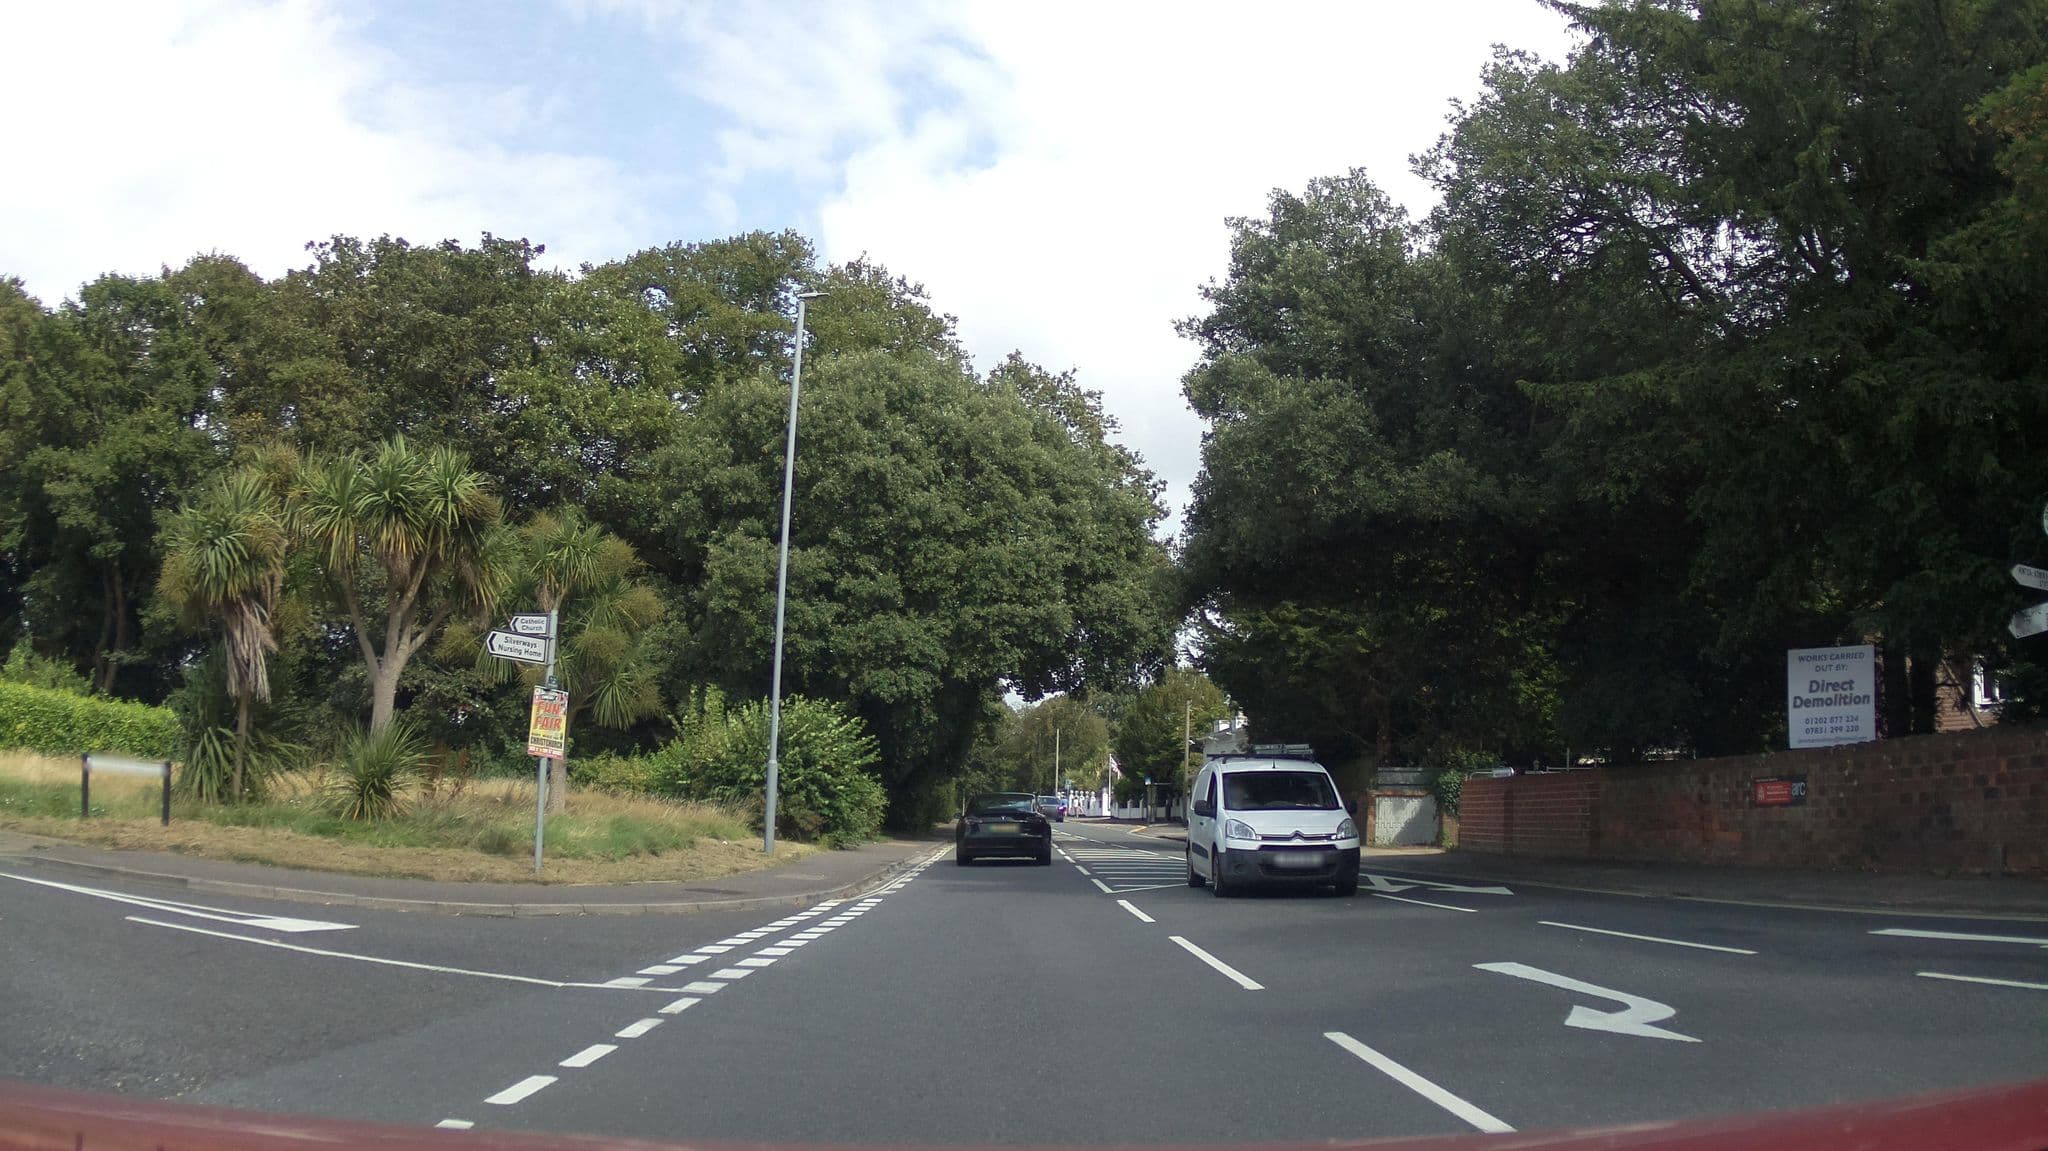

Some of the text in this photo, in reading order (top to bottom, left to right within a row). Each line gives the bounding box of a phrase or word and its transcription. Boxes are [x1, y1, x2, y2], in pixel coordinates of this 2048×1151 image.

[504, 636, 537, 648] Silverways
[497, 643, 542, 658] Nursing Home
[1798, 652, 1865, 663] WORKS CARRIED
[1809, 680, 1855, 693] Direct
[535, 700, 561, 715] FUN
[1792, 693, 1871, 709] Demolition
[533, 715, 563, 731] FAIR
[1804, 717, 1828, 725] 01202
